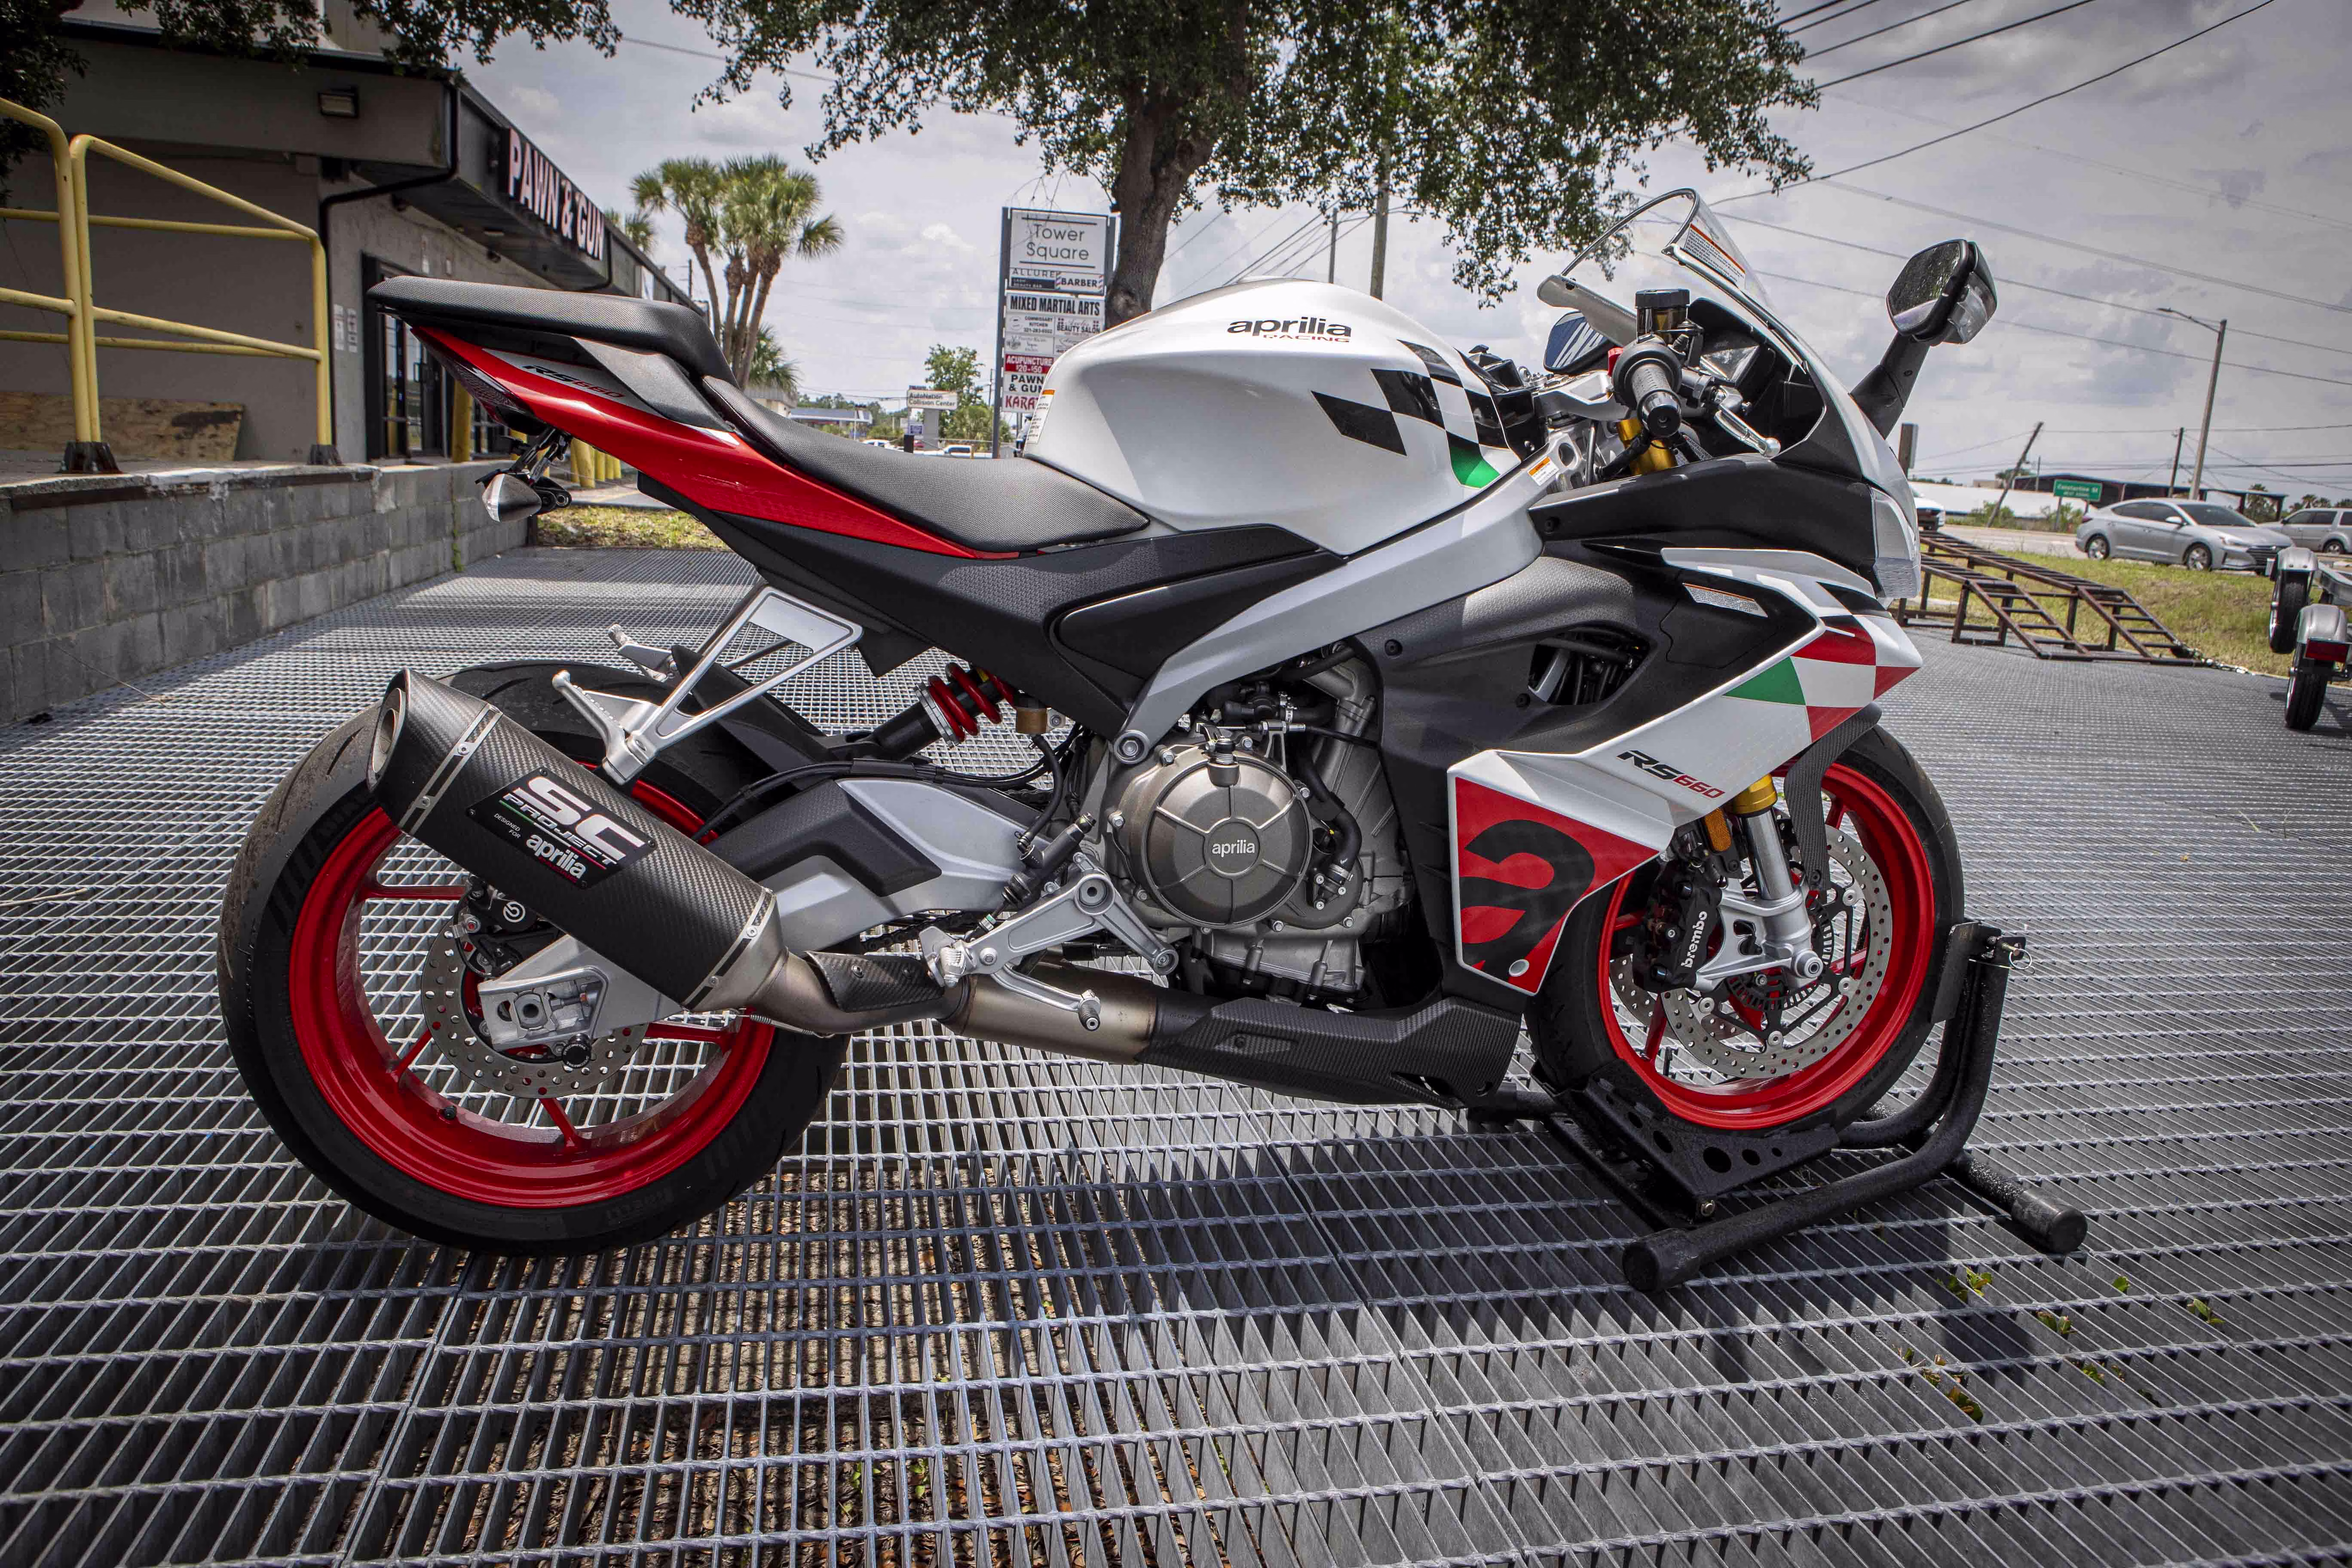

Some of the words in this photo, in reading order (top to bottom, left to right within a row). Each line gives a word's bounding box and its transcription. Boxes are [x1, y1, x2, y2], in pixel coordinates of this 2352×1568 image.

[509, 127, 559, 229] PAWN
[561, 181, 573, 239] &
[576, 194, 604, 261] GUN
[1033, 223, 1085, 242] Tower
[1026, 242, 1089, 260] Square
[1012, 268, 1057, 278] ALLURE
[1062, 278, 1097, 287] BARBER
[1010, 295, 1037, 311] MIXED
[1039, 297, 1076, 315] MARTIAL
[1078, 301, 1100, 316] ARTS
[1057, 324, 1079, 332] BEAUTY
[1227, 317, 1352, 337] aprilia
[1263, 334, 1351, 343] RACING
[1006, 355, 1053, 365] ACUPUNCTURE
[523, 365, 626, 398] RS660
[1009, 383, 1017, 392] &
[1011, 374, 1044, 384] PAWN
[1005, 395, 1039, 410] KARA
[1616, 750, 1725, 799] RS660
[494, 813, 521, 831] DESIGNED
[512, 777, 644, 860] SC
[503, 793, 617, 865] PROJECT
[509, 829, 521, 839] FOR
[526, 834, 586, 879] aprilia
[1212, 839, 1255, 858] aprilia
[1681, 911, 1707, 968] brembo
